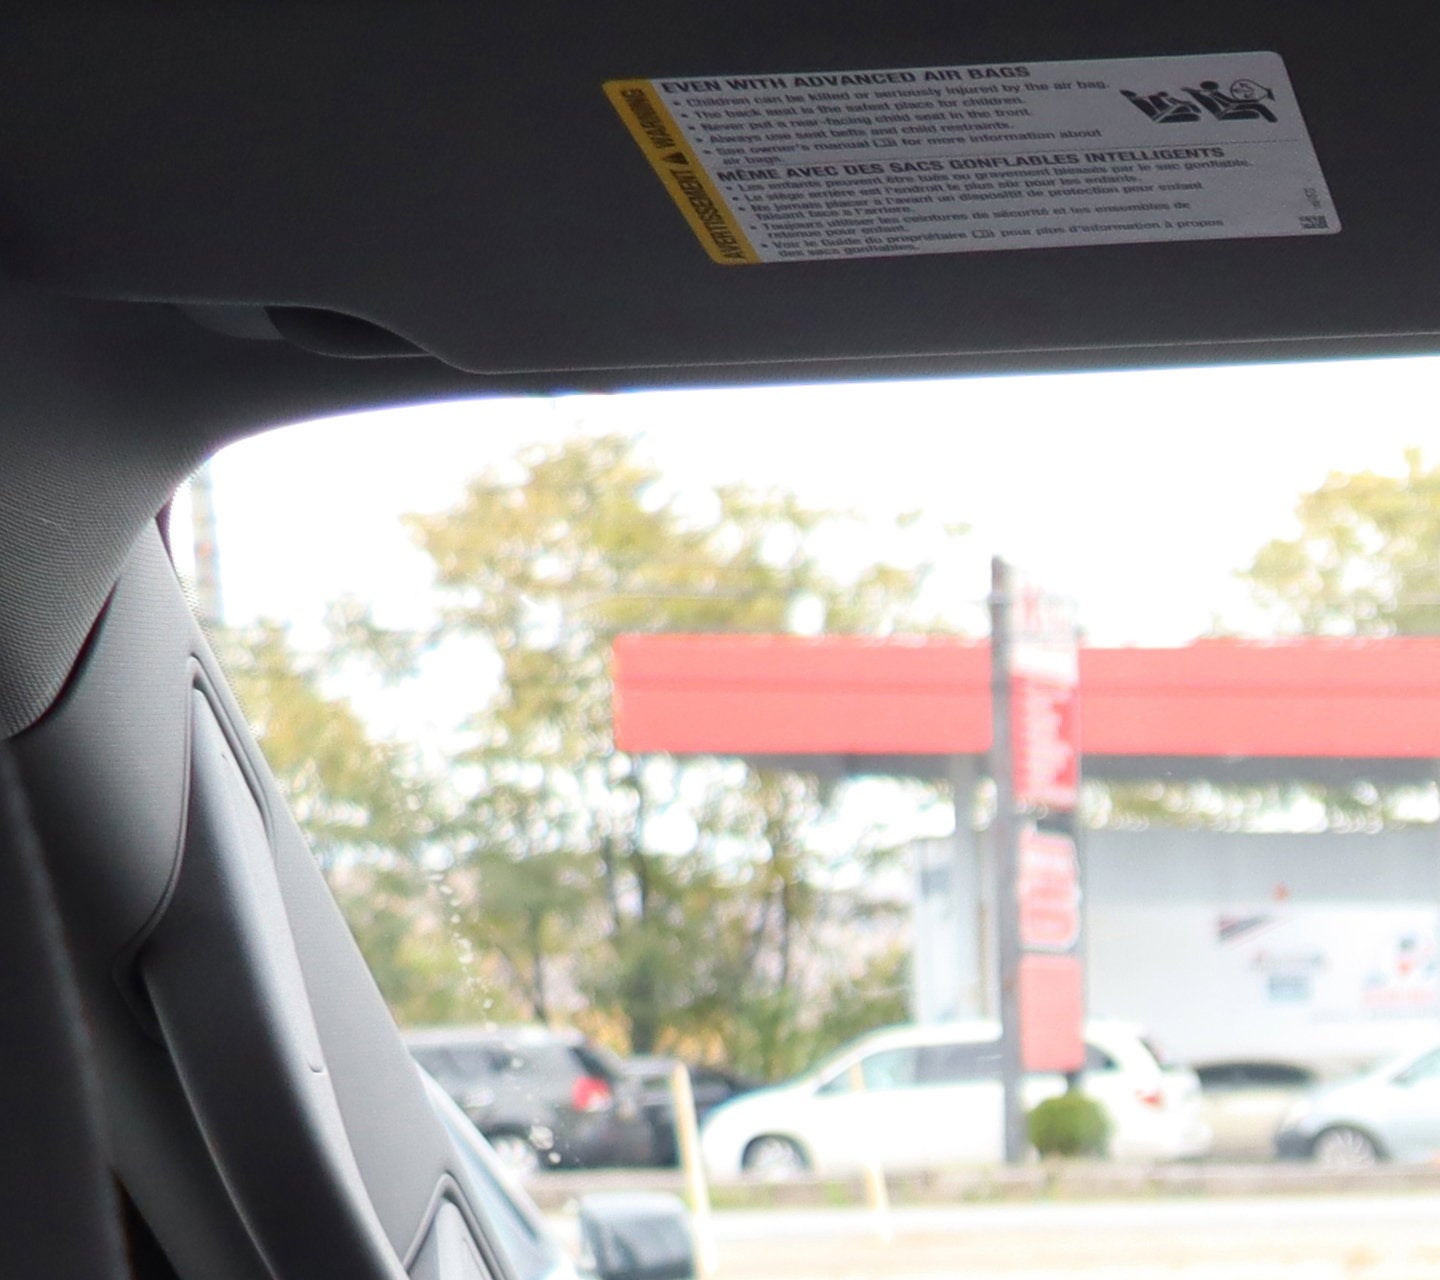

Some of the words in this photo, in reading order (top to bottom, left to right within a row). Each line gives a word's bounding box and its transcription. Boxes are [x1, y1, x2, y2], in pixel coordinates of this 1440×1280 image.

[662, 80, 722, 93] EVEN
[725, 77, 787, 90] WITH
[793, 72, 916, 87] ADVANCED
[924, 70, 962, 81] AIR
[966, 66, 1030, 79] BAGS
[716, 166, 781, 181] MÊME
[786, 165, 838, 177] AVEC
[842, 163, 885, 175] DES
[888, 160, 944, 172] SACS
[948, 154, 1079, 169] GONFLABLES
[1084, 147, 1226, 162] INTELLIGENTS
